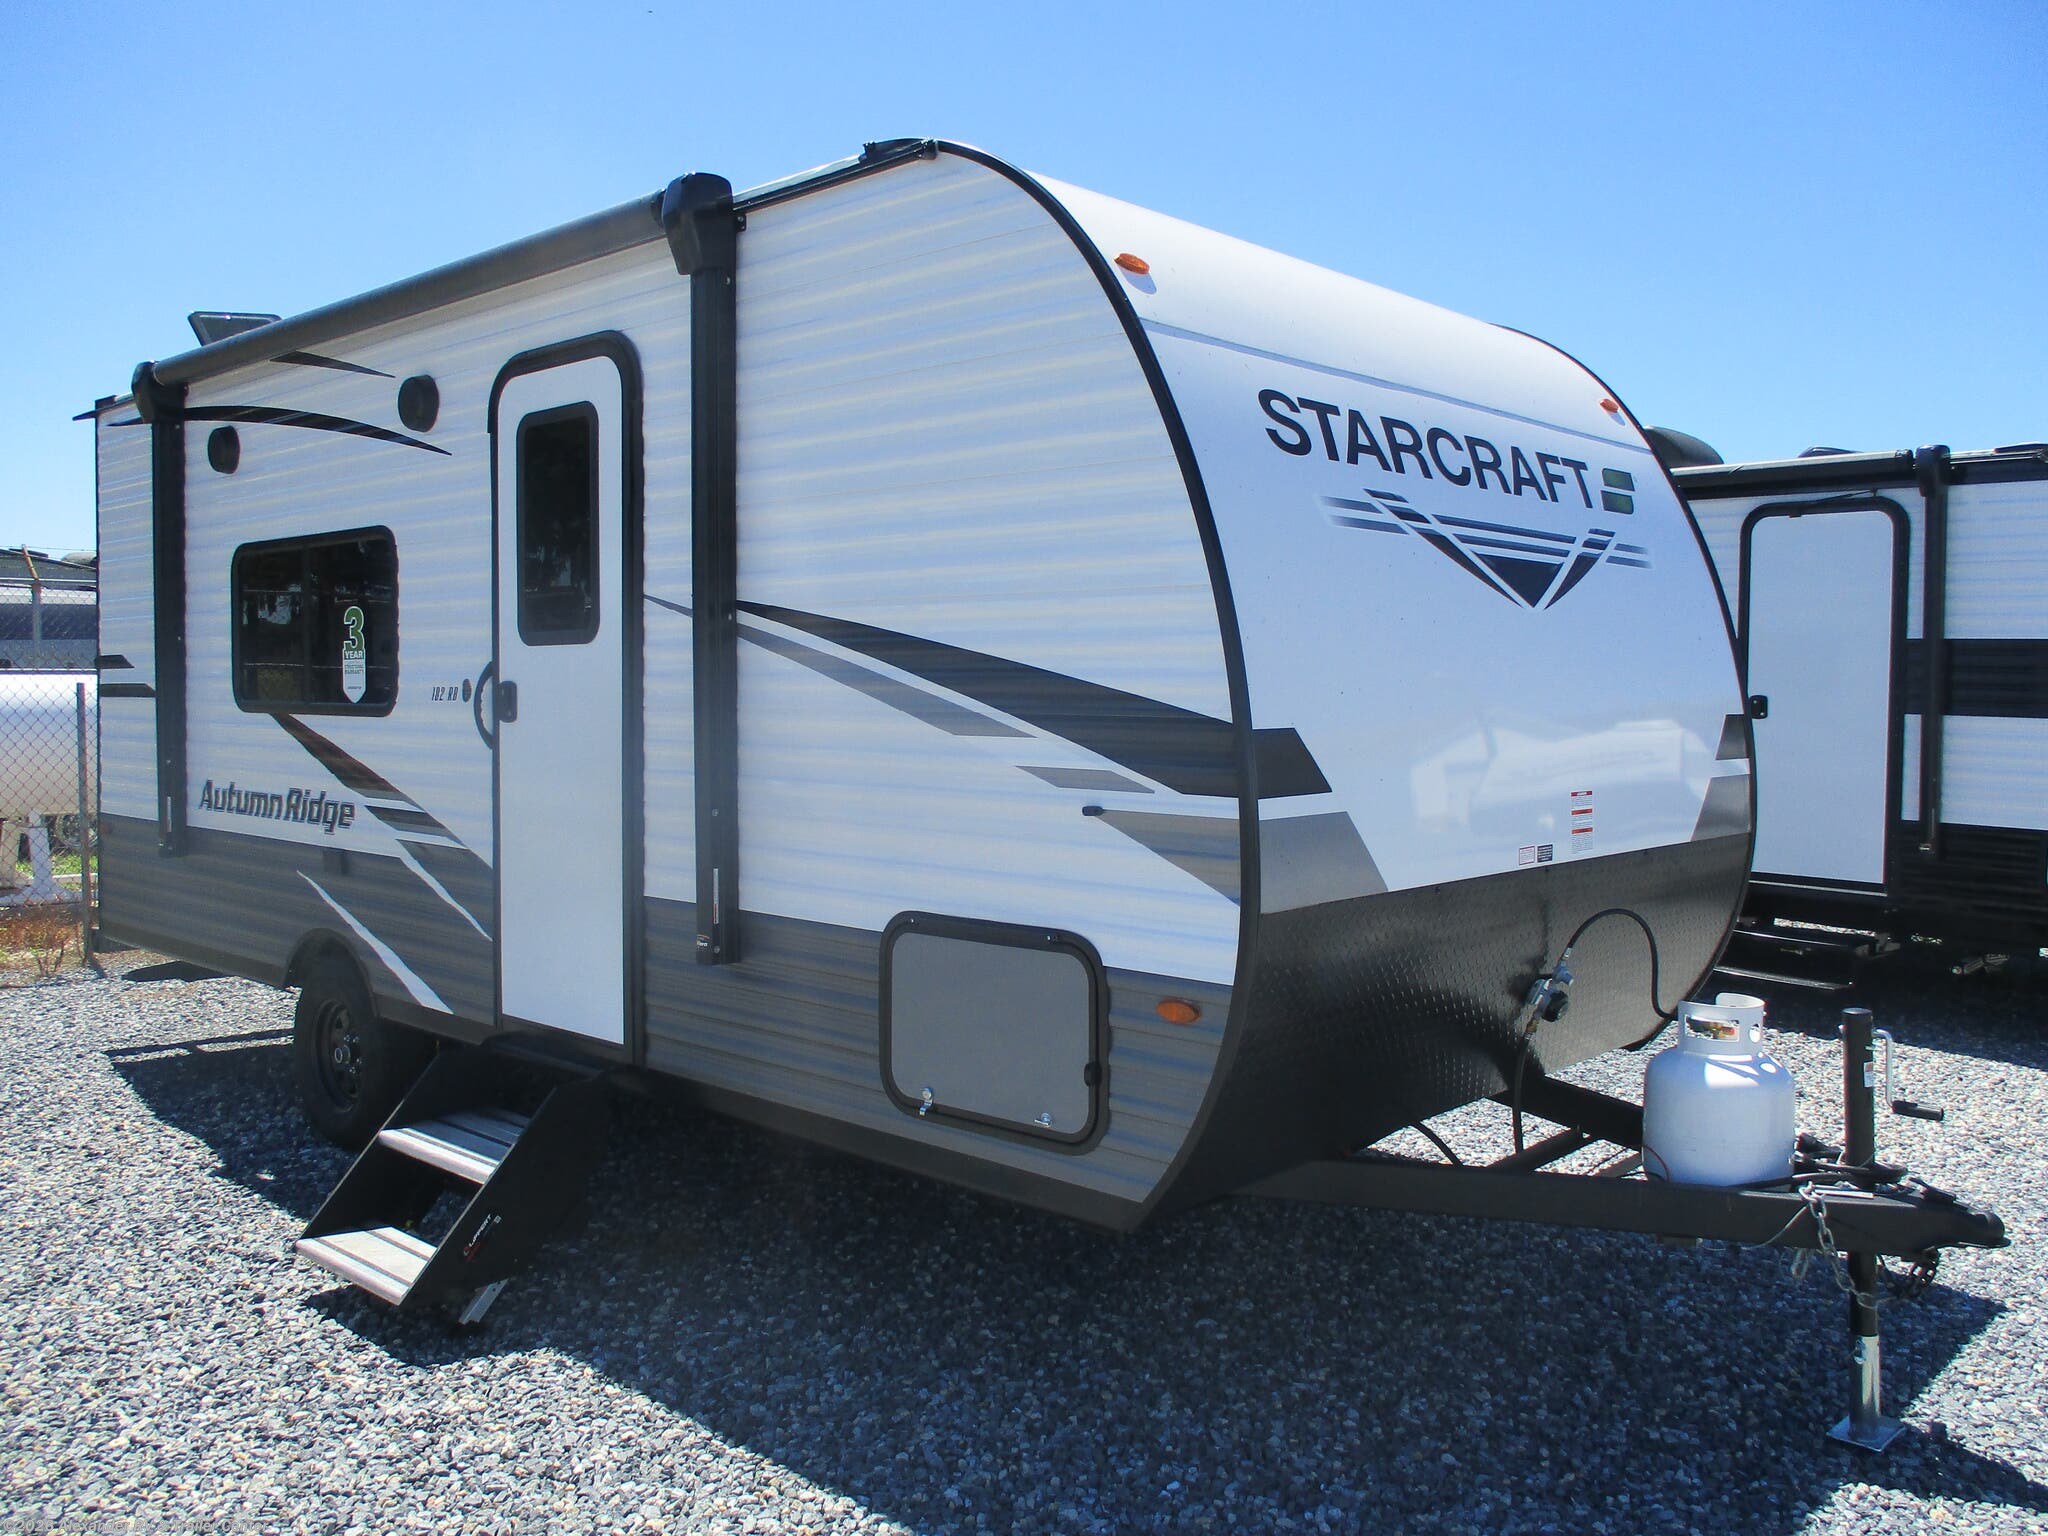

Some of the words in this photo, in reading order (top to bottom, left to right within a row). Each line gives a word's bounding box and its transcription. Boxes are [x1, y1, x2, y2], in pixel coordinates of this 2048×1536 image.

[1258, 388, 1593, 509] STARCRAFT
[344, 606, 364, 651] 3
[344, 651, 363, 659] YEAR
